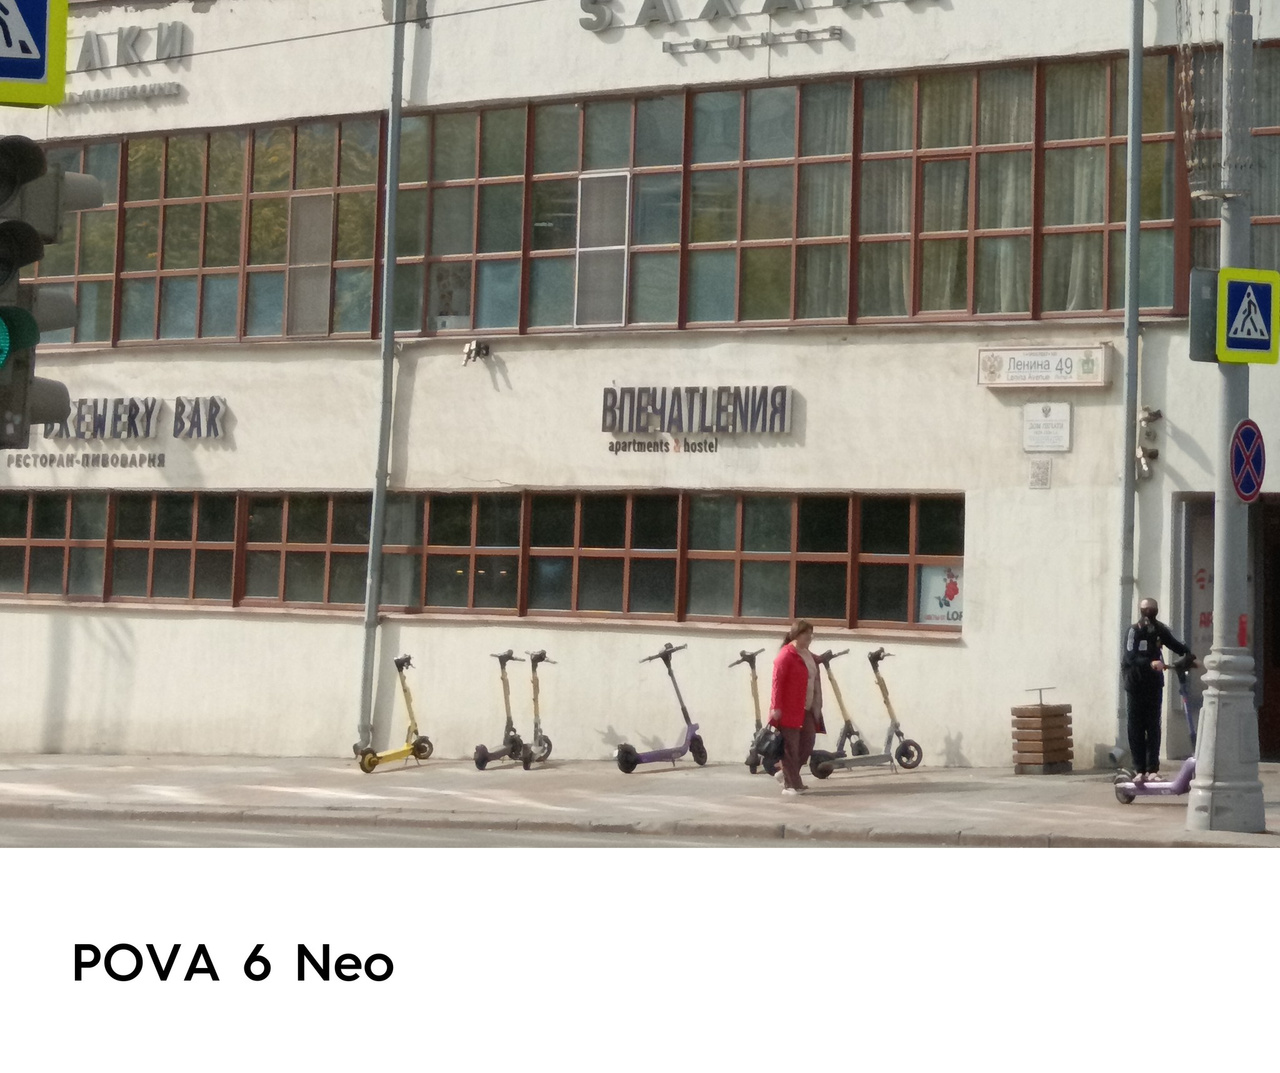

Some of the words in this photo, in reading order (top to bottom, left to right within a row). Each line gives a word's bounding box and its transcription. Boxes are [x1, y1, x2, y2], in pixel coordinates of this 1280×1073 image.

[76, 21, 187, 73] АКИ
[1008, 357, 1050, 371] Ленина
[1055, 357, 1073, 375] 49
[173, 396, 225, 439] BAR
[608, 439, 670, 455] apartments
[683, 437, 718, 453] hostel
[6, 453, 166, 469] РЕСТОРАН-ПИВОВАРНЯ
